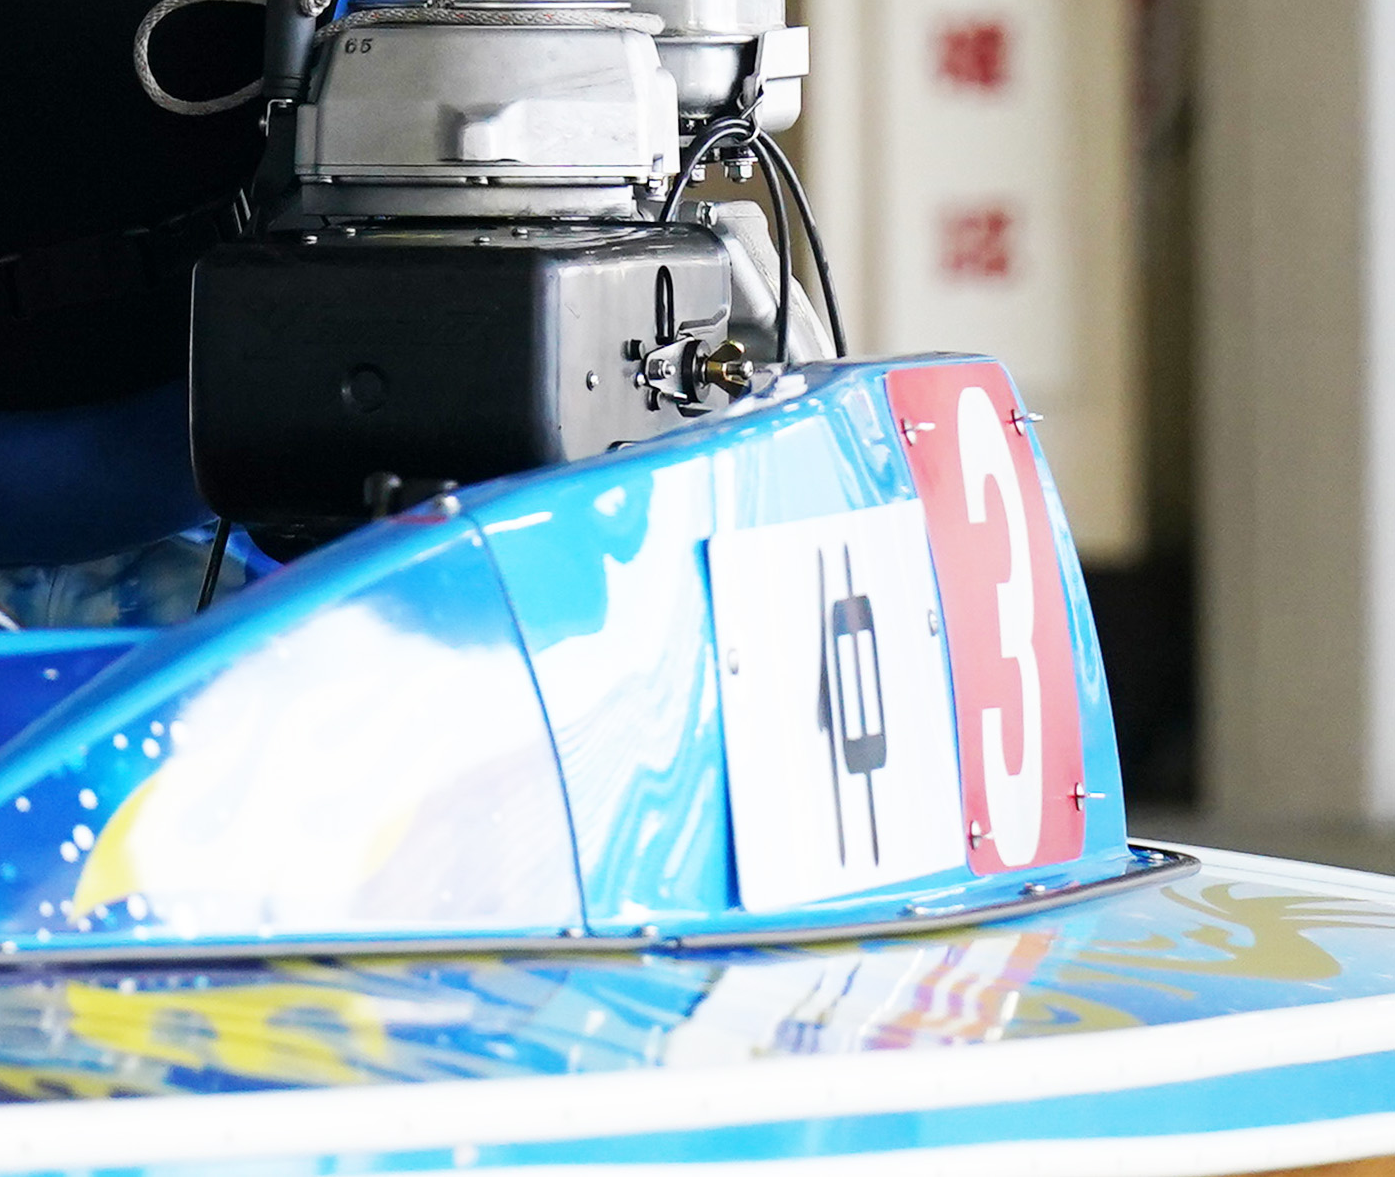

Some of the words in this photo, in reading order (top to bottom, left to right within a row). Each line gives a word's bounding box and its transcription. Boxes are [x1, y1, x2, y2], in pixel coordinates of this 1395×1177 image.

[344, 38, 373, 54] 65
[816, 542, 887, 868] 仲
[957, 386, 1043, 867] 3
